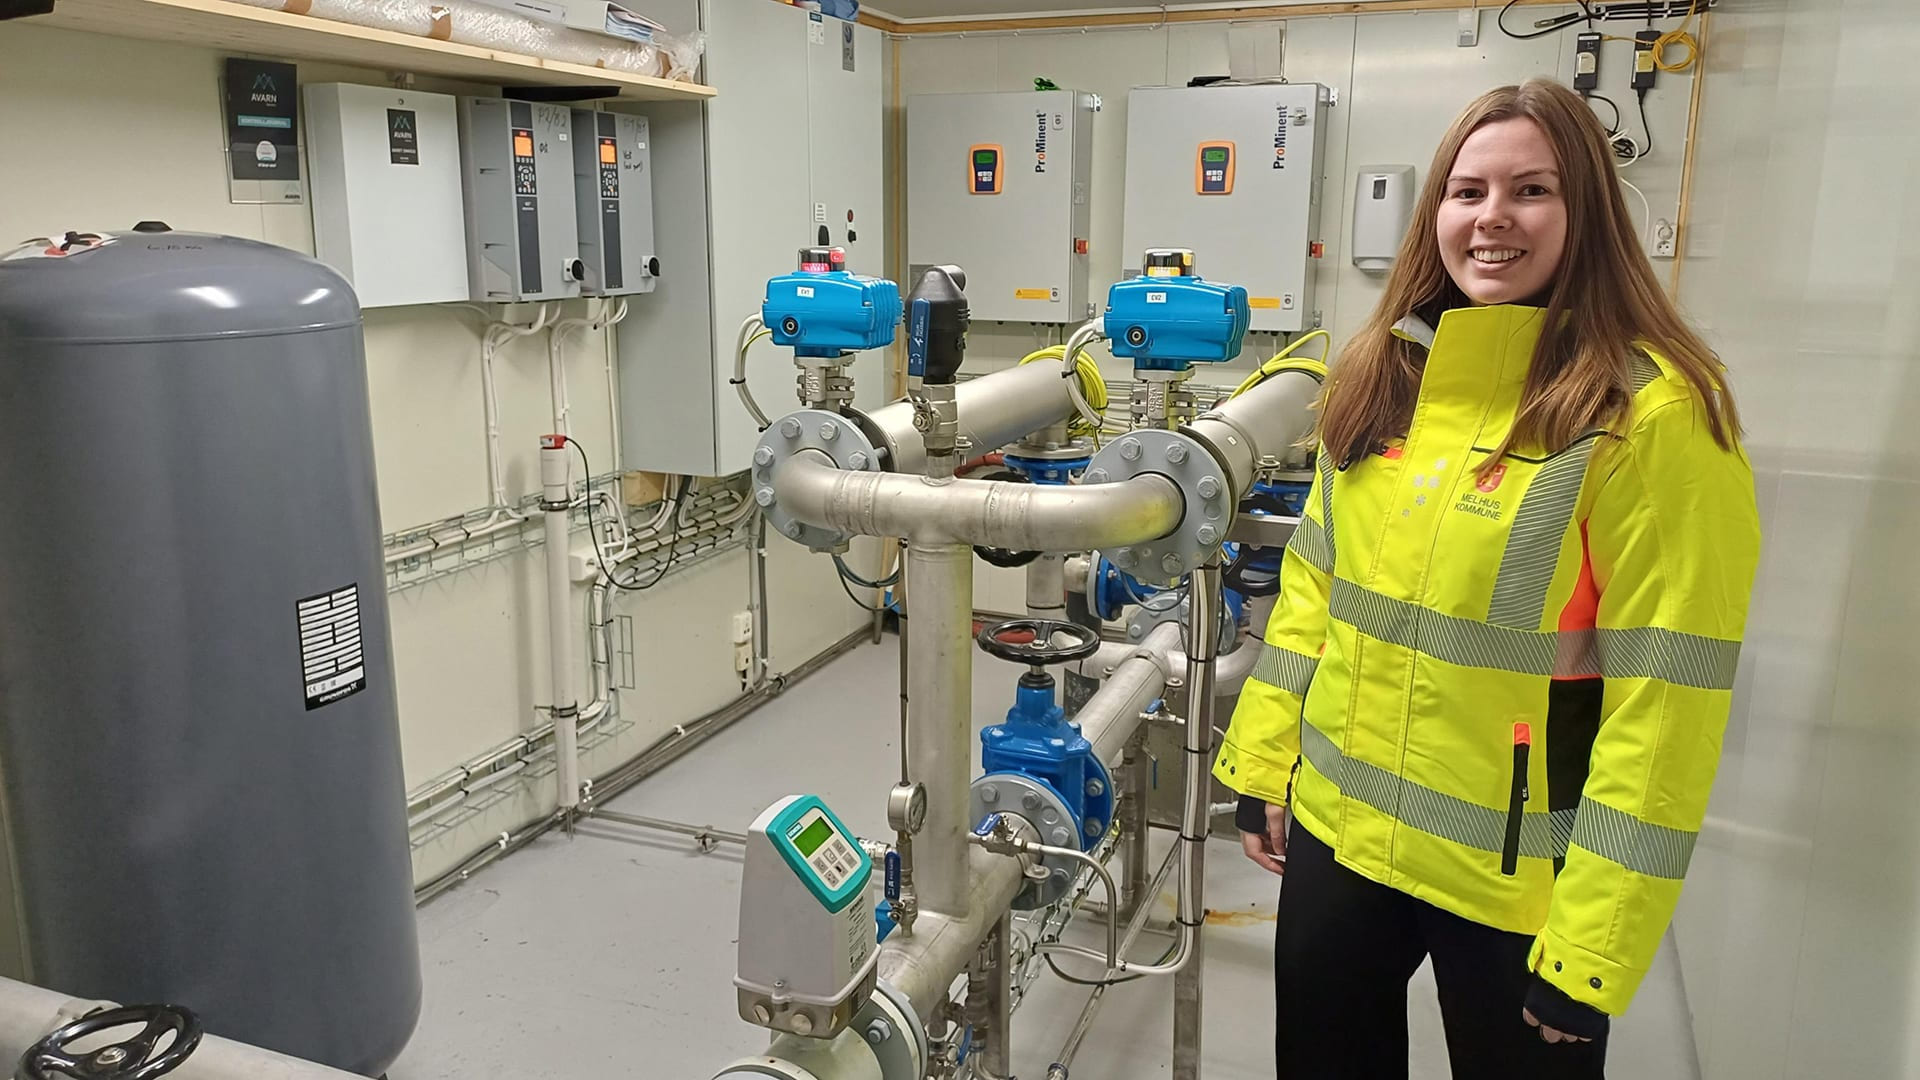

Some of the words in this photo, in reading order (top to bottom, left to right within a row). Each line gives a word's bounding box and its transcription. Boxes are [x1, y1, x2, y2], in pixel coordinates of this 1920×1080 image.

[251, 93, 277, 103] AVARN
[1035, 113, 1046, 172] ProMinent
[1273, 105, 1288, 169] ProMinent
[1461, 493, 1501, 509] MELHUS
[1454, 502, 1502, 520] KOMMUNE
